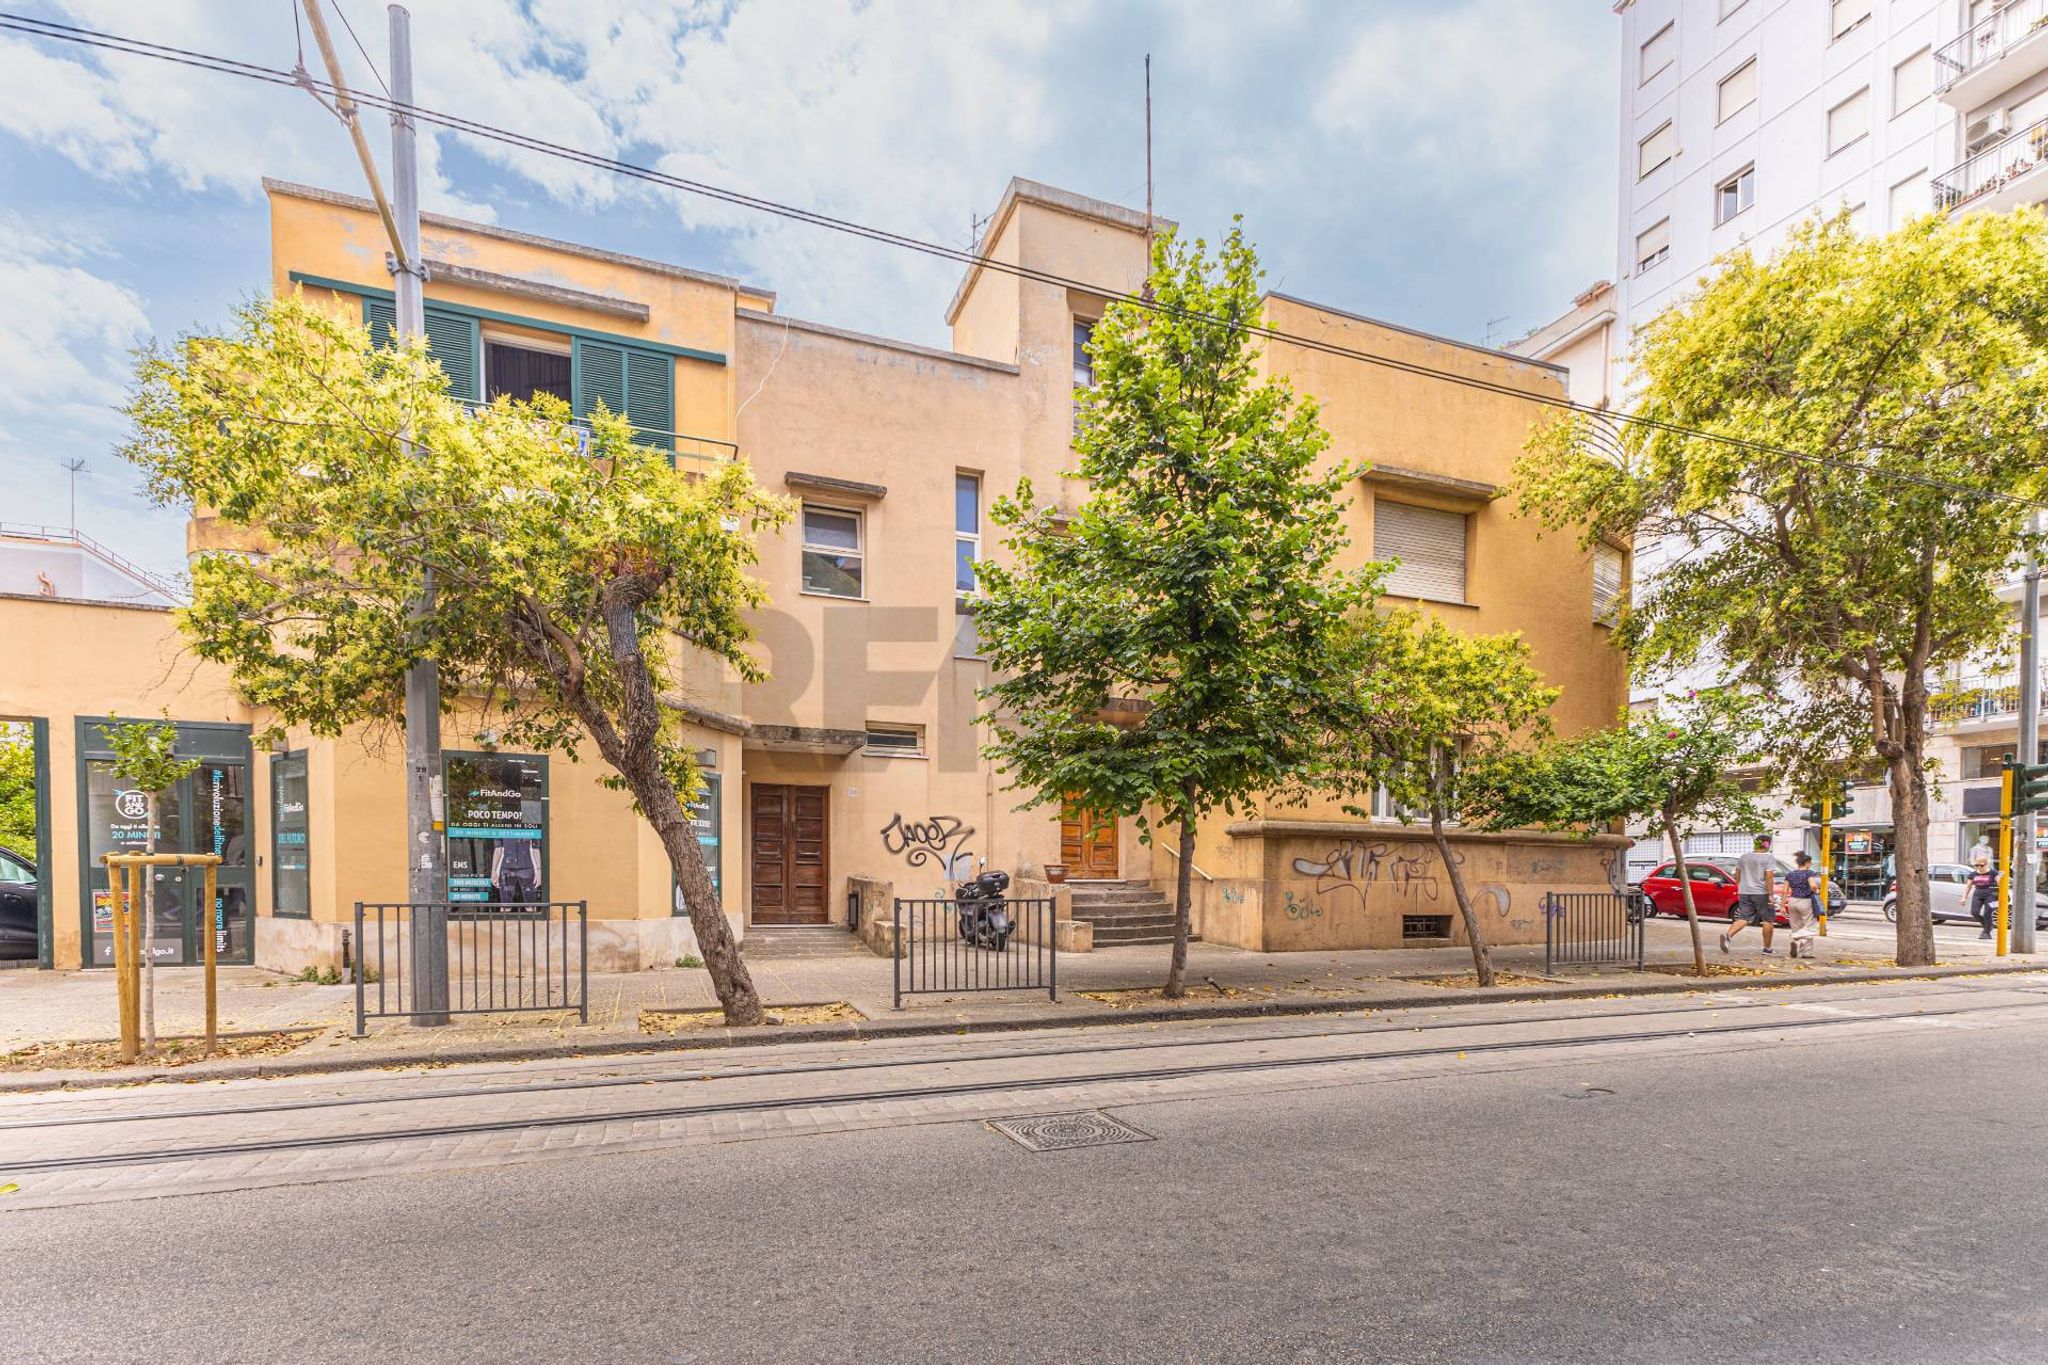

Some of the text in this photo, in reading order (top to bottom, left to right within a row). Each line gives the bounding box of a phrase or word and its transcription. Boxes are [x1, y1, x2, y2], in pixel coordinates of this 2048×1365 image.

[480, 789, 522, 798] FitAndGo
[124, 807, 145, 815] GO
[468, 810, 491, 819] POCO
[111, 831, 125, 839] 20
[453, 861, 468, 869] EMS
[215, 897, 228, 953] no more limits
